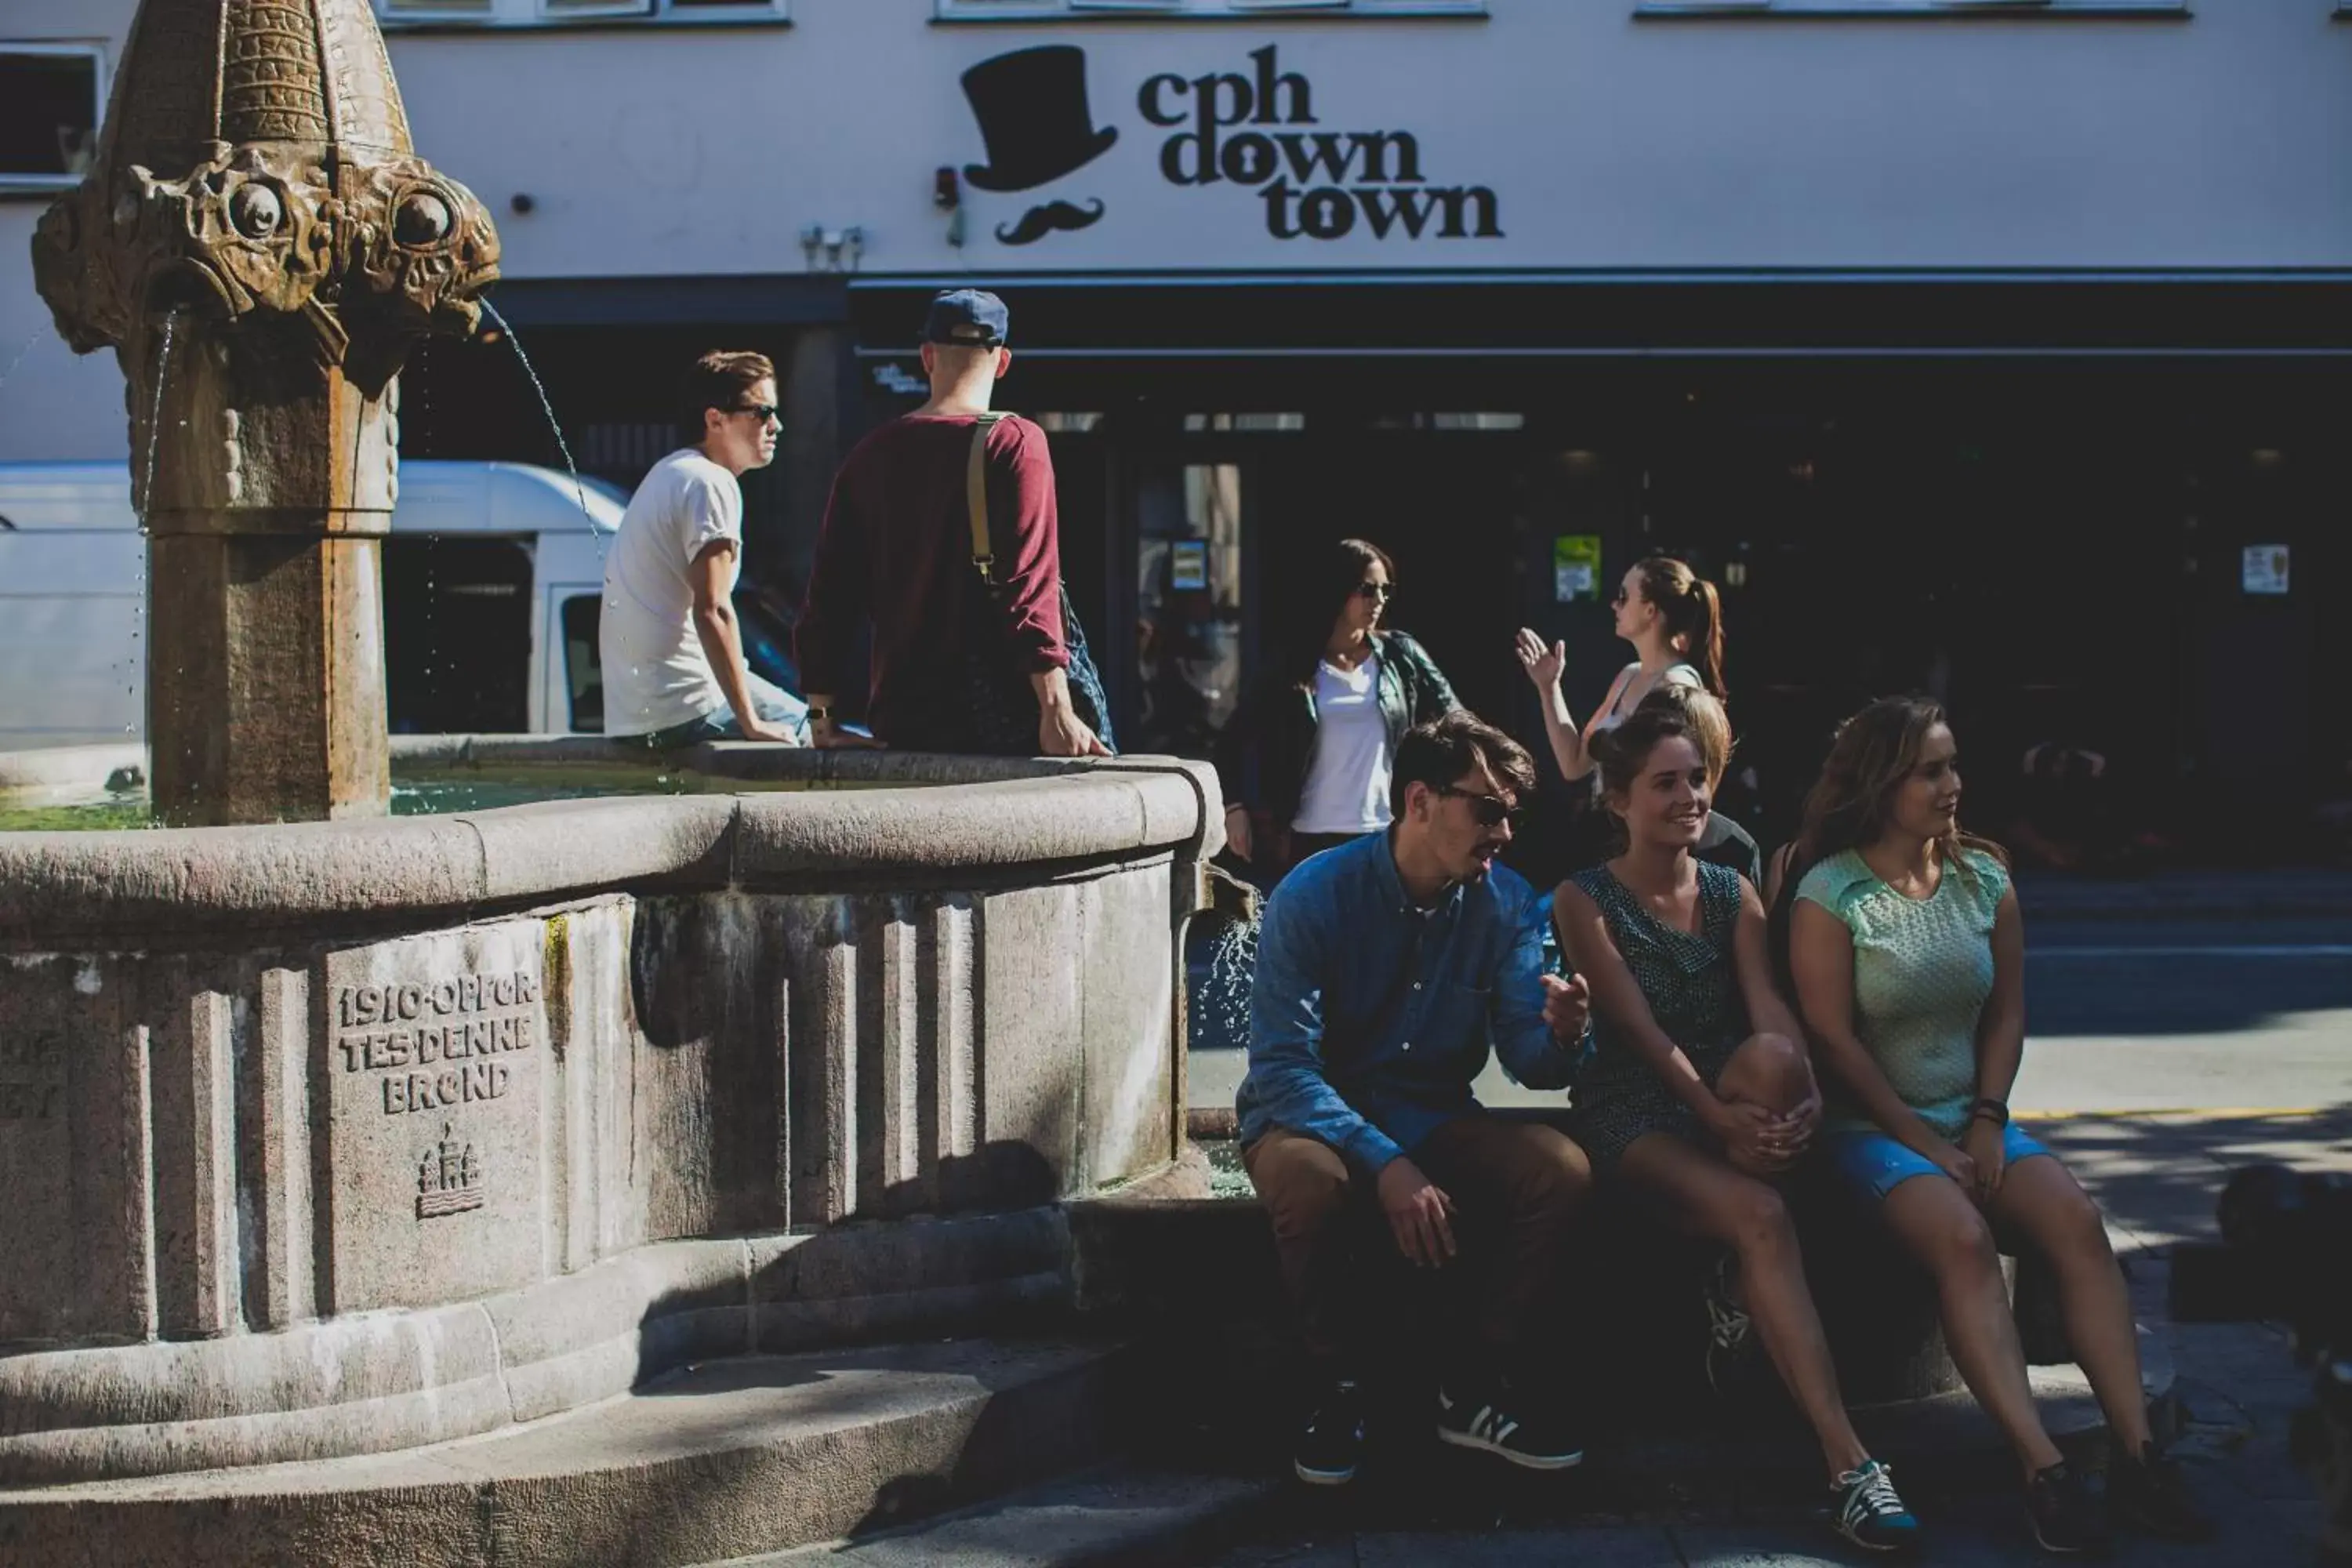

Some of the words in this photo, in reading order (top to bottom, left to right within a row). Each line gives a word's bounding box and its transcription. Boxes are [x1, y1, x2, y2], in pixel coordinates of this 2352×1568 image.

[1137, 42, 1319, 161] cph
[1159, 122, 1427, 186] down
[1258, 174, 1506, 241] town
